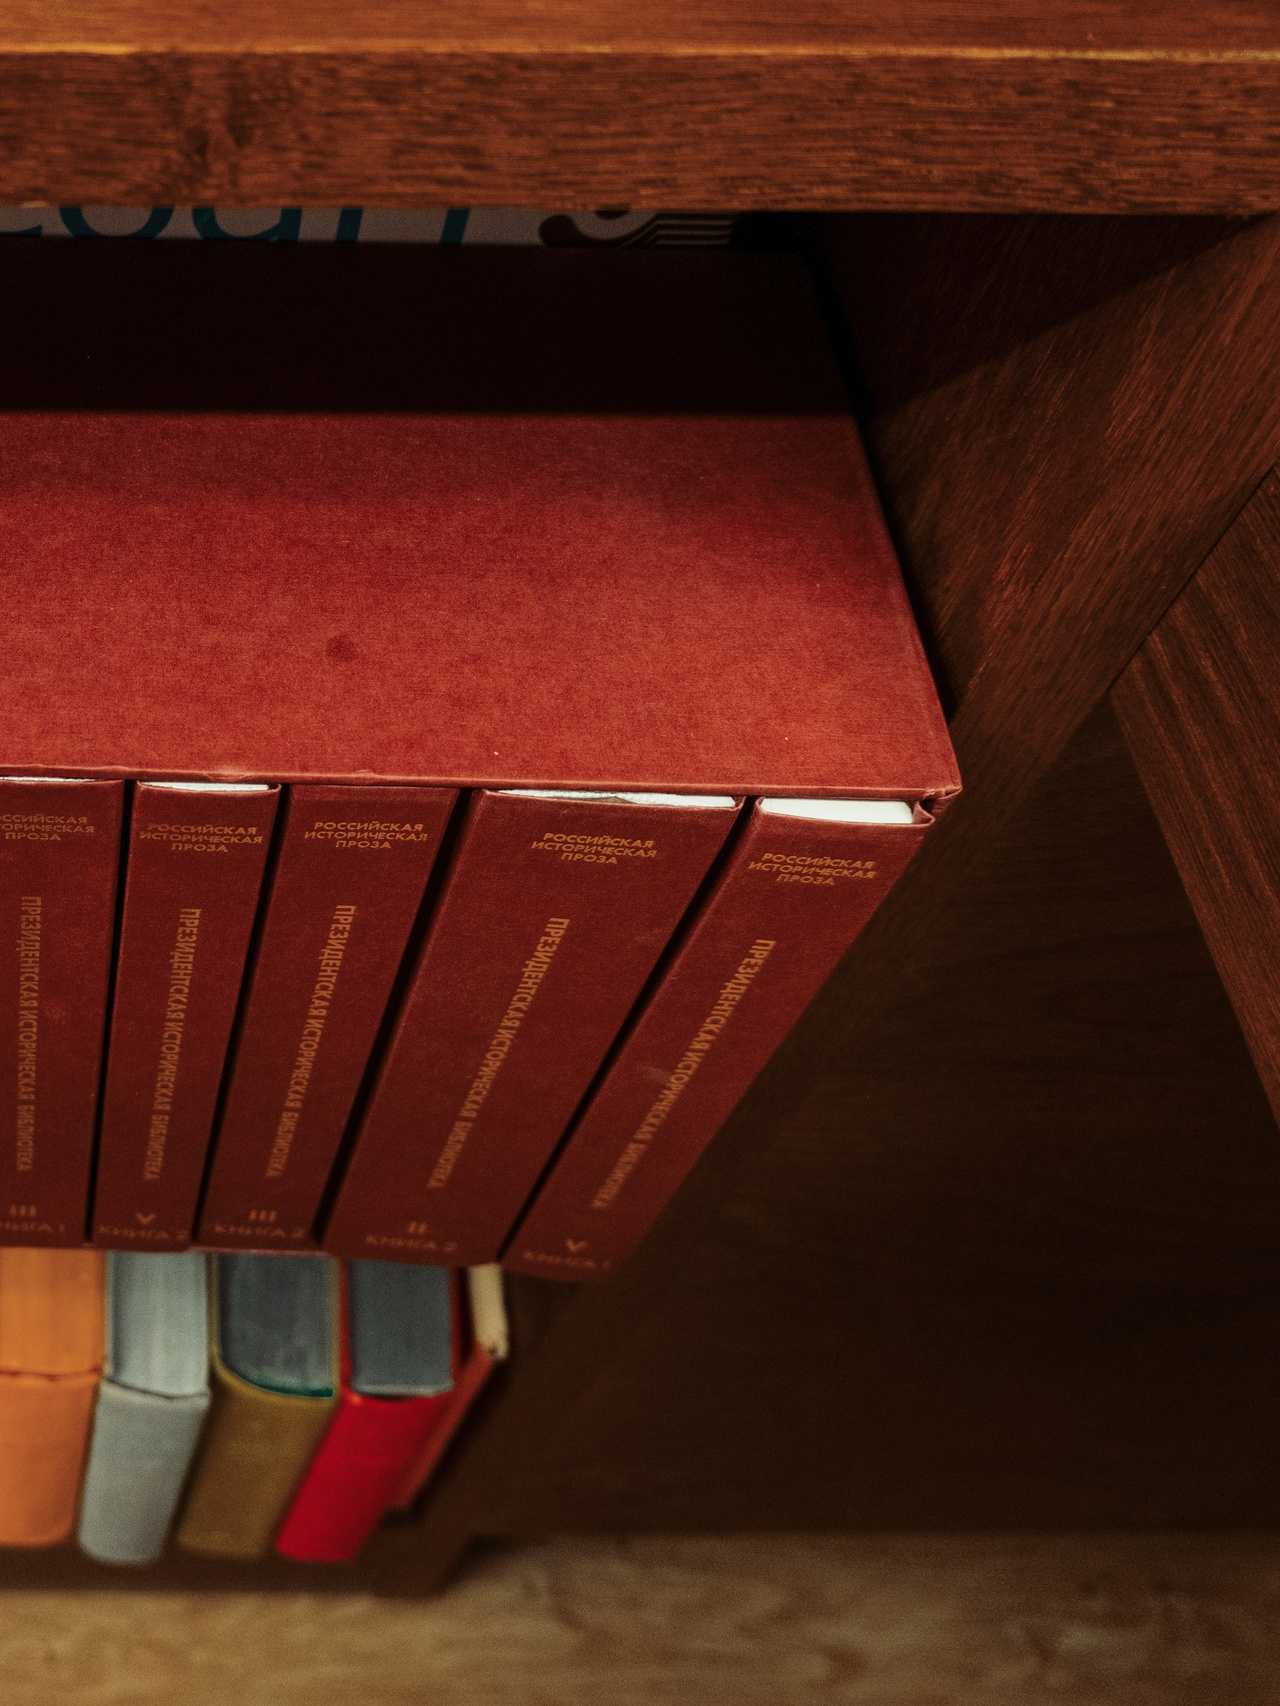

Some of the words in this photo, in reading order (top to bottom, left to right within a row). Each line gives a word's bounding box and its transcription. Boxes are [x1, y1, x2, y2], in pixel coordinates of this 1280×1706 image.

[147, 823, 257, 835] РОССИЙСКАЯ
[314, 820, 424, 832] РОССИЙСКАЯ
[5, 832, 61, 840] ПРОЗА
[140, 831, 263, 844] ИСТОРИЧЕСКАЯ
[304, 831, 428, 841] ИСТОРИЧЕСКАЯ
[543, 832, 654, 848] РОССИЙСКАЯ
[171, 842, 228, 852] ПРОЗА
[335, 840, 391, 849] ПРОЗА
[531, 841, 657, 858] ИСТОРИЧЕСКАЯ
[560, 852, 618, 864] ПРОЗА
[761, 853, 876, 869] РОССИЙСКАЯ
[748, 862, 878, 879] ИСТОРИЧЕСКАЯ
[776, 874, 835, 886] ПРОЗА
[16, 896, 41, 1007] ПРЕЗИДЕНТСКАЯ
[165, 908, 202, 1019] ПРЕЗИДЕНТСКАЯ
[309, 904, 356, 1016] ПРЕЗИДЕНТСКАЯ
[501, 917, 570, 1027] ПРЕЗИДЕНТСКАЯ
[689, 939, 776, 1050] ПРЕЗИДЕНТСКАЯ
[17, 1010, 38, 1101] ИСТОРИЧЕСКАЯ
[285, 1019, 325, 1108] ИСТОРИЧЕСКАЯ
[153, 1022, 184, 1111] ИСТОРИЧЕСКАЯ
[459, 1029, 516, 1118] ИСТОРИЧЕСКАЯ
[633, 1052, 706, 1141] ИСТОРИЧЕСКАЯ
[9, 1204, 36, 1217] III
[135, 1211, 157, 1225] V
[248, 1209, 278, 1223] III
[565, 1238, 589, 1252] V
